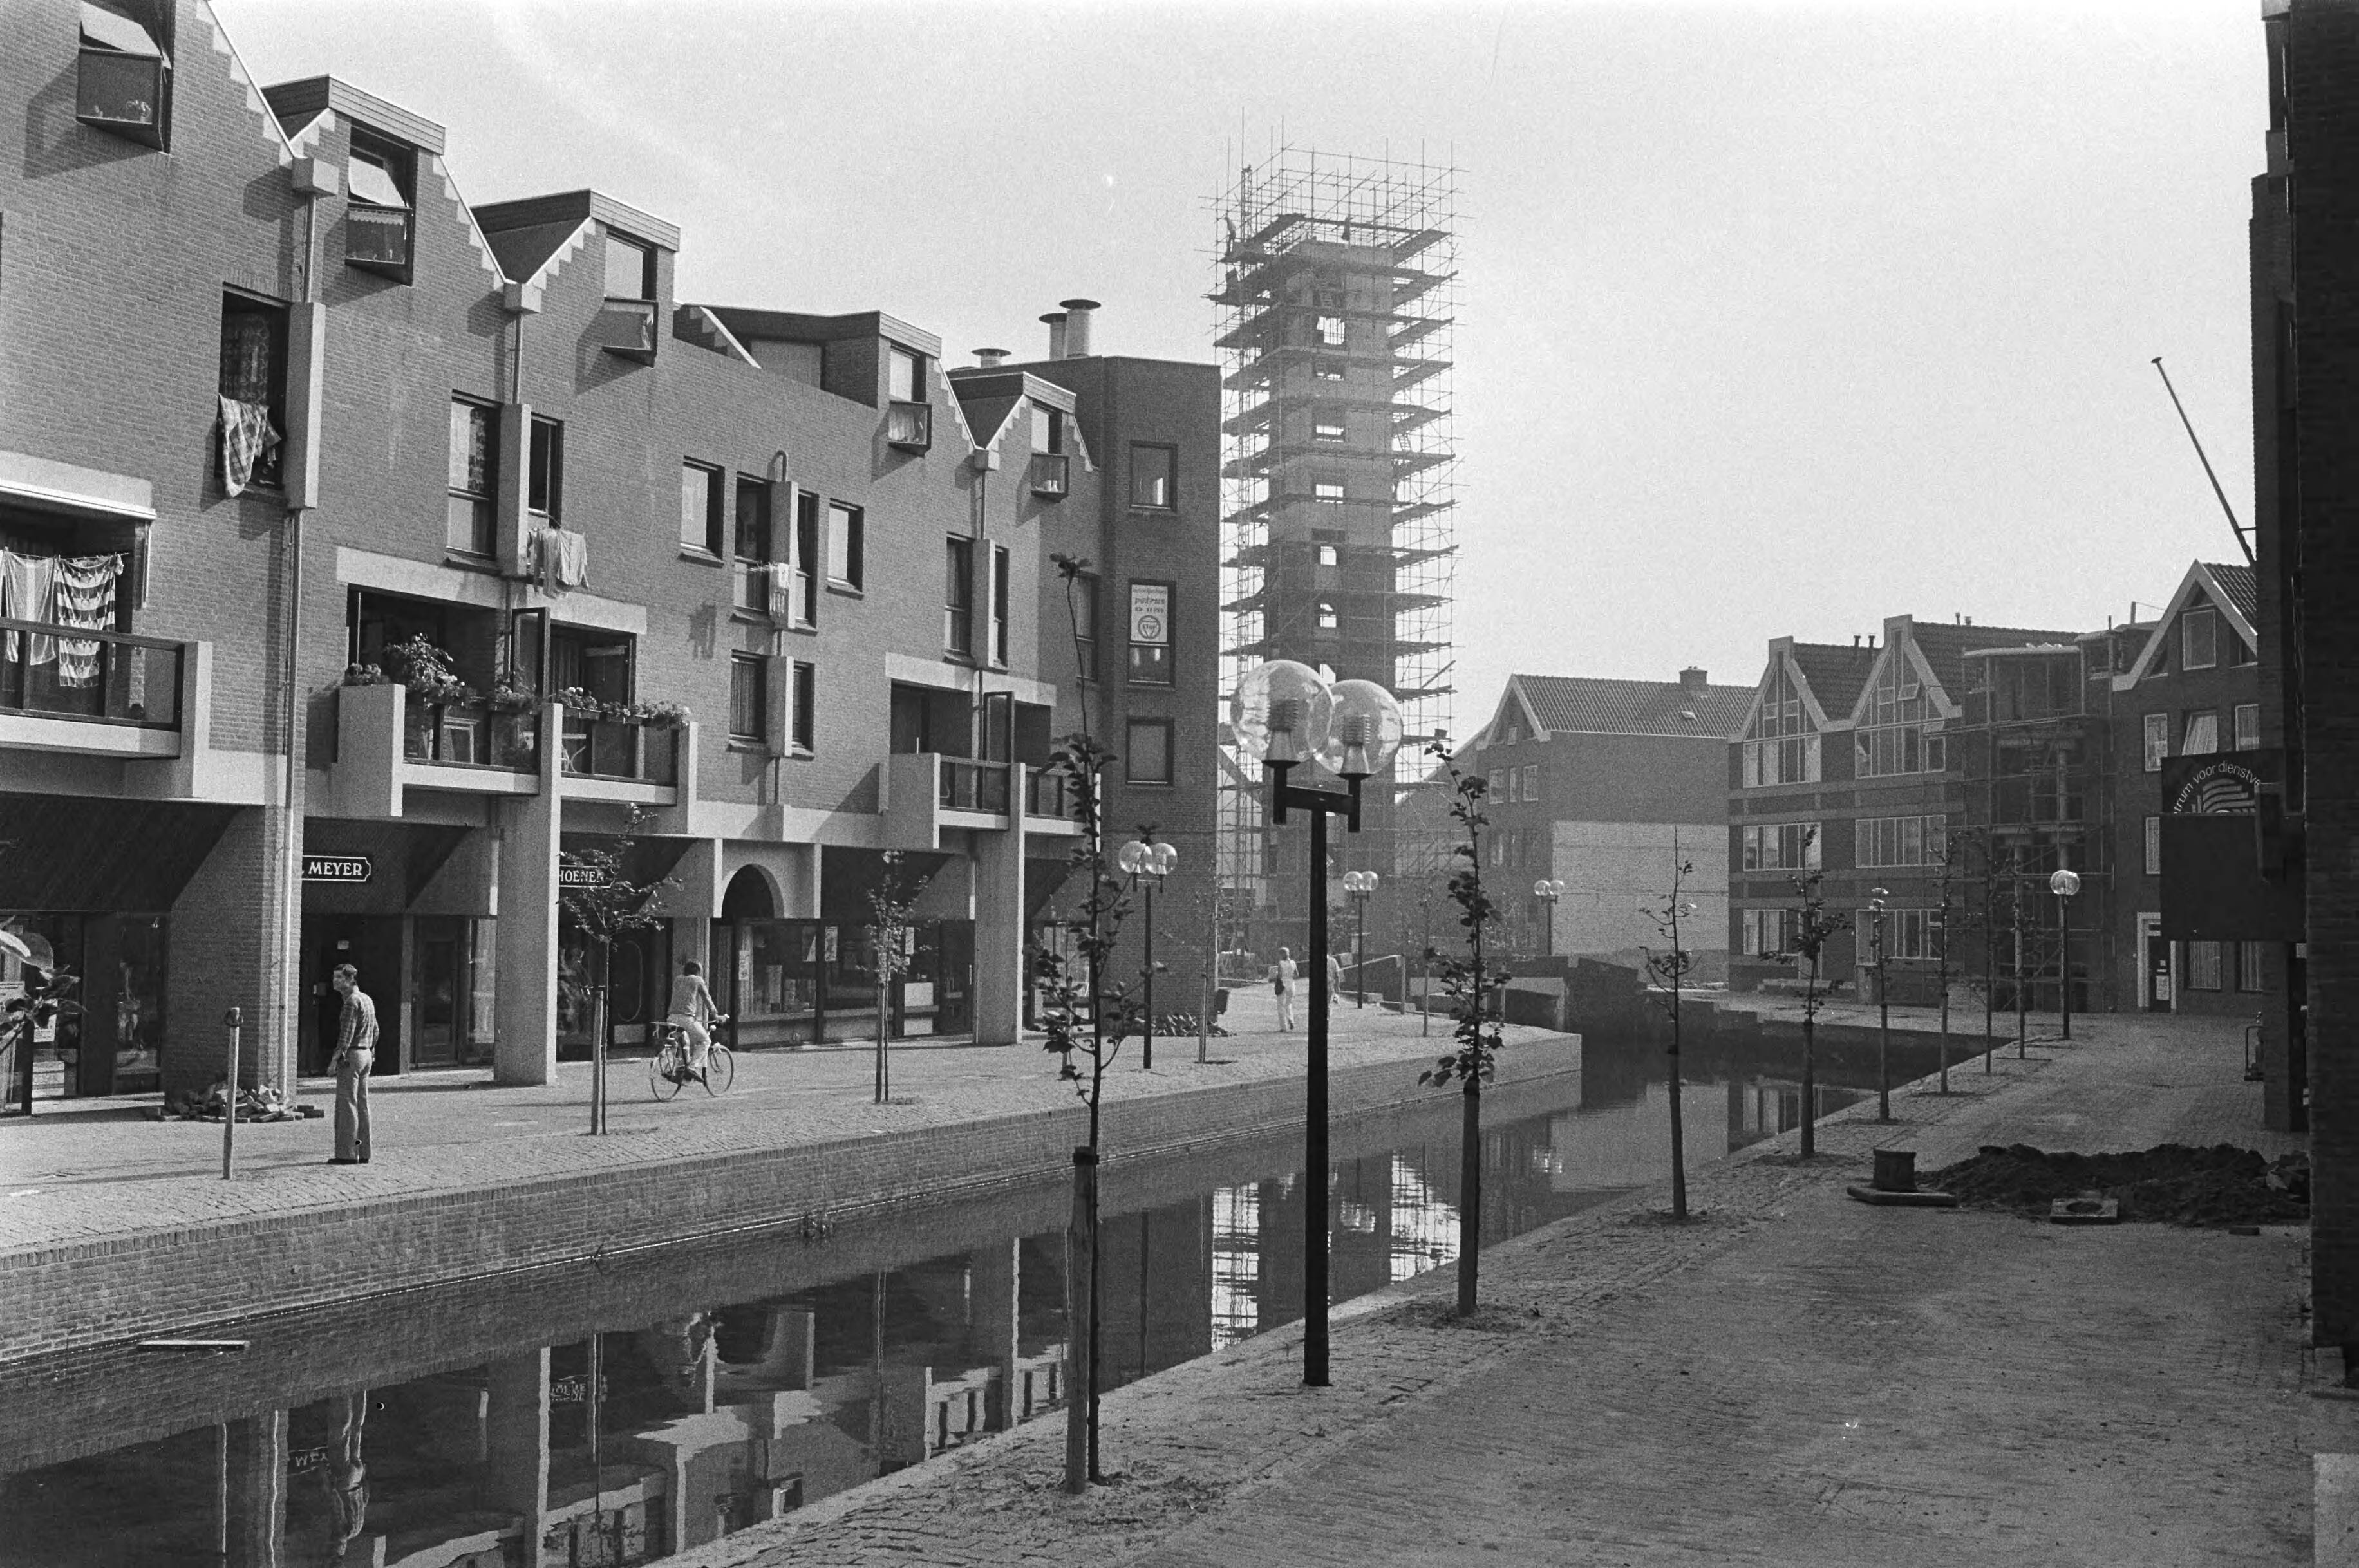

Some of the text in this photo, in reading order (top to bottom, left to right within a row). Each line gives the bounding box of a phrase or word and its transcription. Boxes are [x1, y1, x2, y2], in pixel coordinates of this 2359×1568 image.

[2174, 783, 2194, 814] trum
[2193, 765, 2215, 783] voor
[308, 861, 362, 875] MEYER
